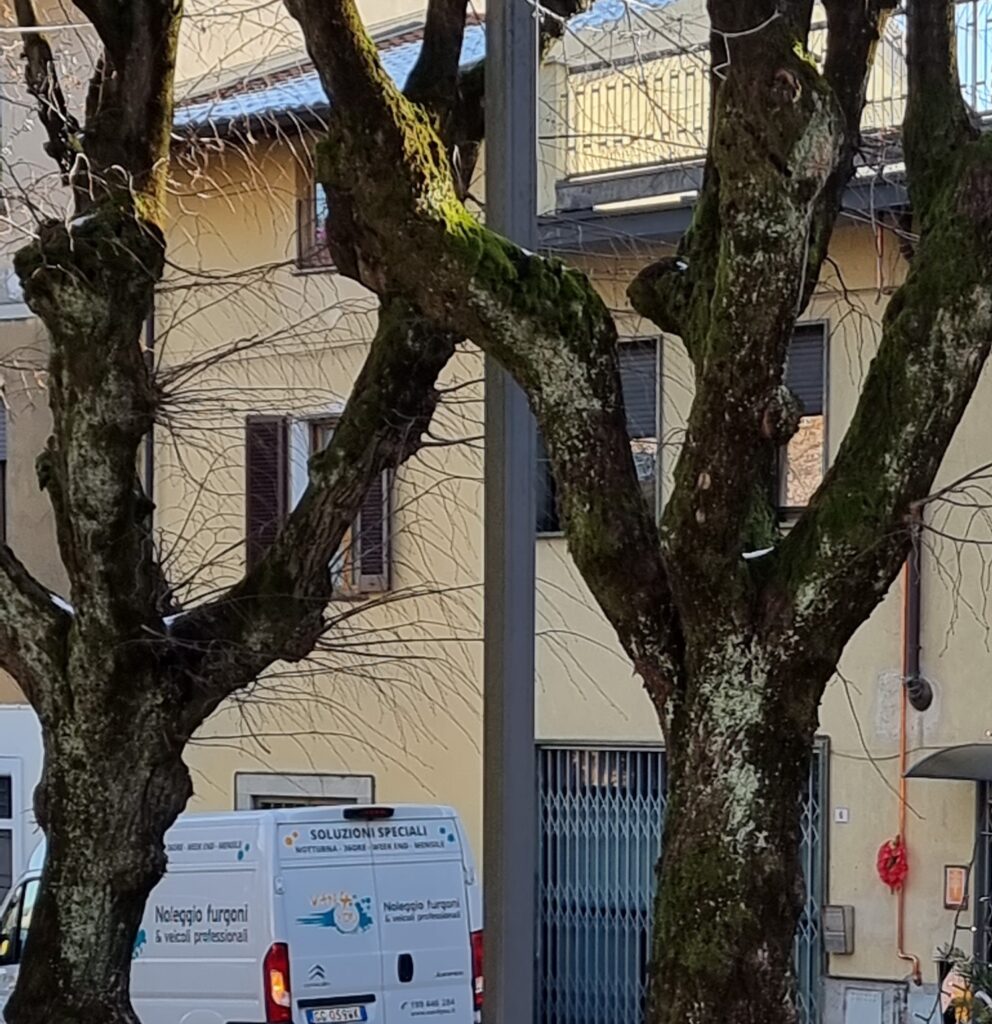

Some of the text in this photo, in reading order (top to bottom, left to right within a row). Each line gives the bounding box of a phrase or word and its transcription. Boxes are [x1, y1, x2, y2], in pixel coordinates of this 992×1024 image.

[310, 825, 427, 841] SOLUZIONI SPECIALI
[383, 899, 460, 913] Noleggio furgoni
[155, 903, 249, 927] Noleggio furgoni
[164, 929, 191, 943] veicoli
[193, 928, 248, 945] professionali
